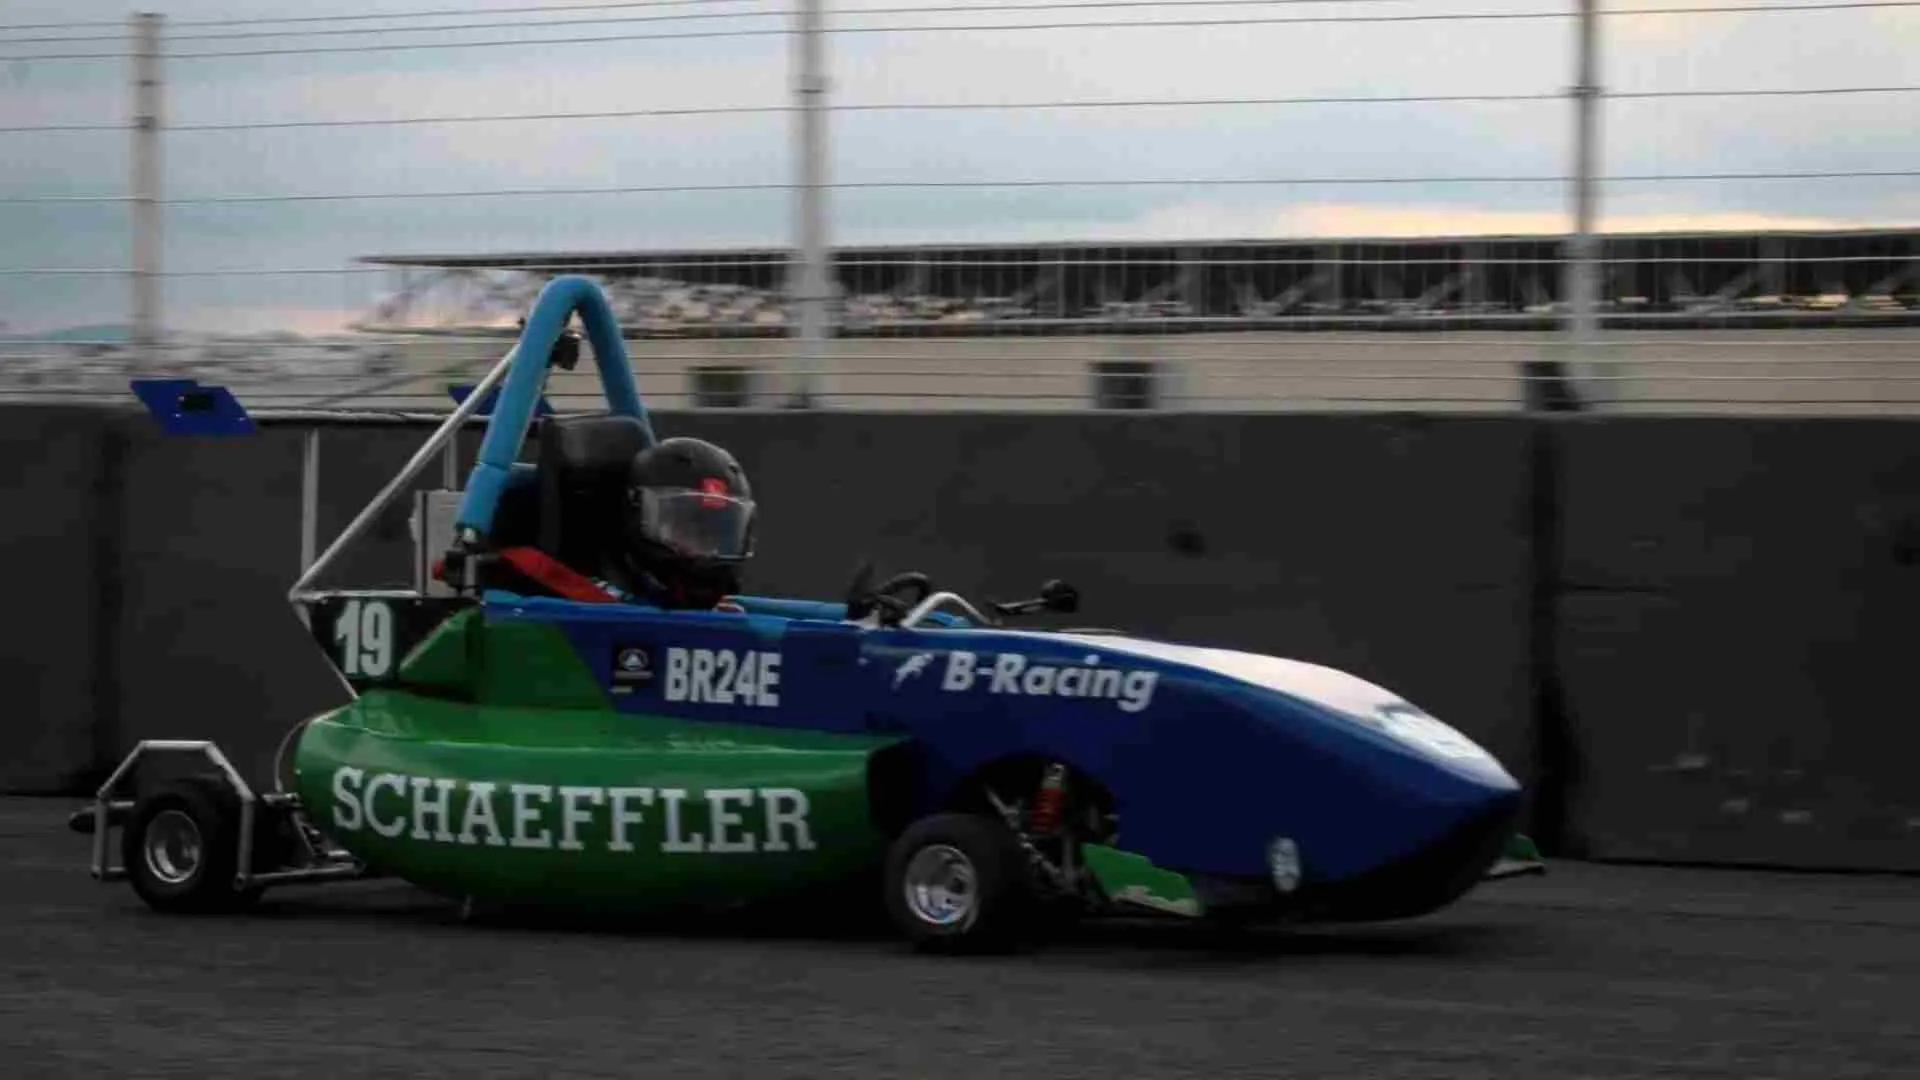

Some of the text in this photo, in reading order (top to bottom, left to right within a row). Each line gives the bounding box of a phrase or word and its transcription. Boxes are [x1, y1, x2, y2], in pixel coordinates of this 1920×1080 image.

[334, 599, 393, 677] 19
[664, 647, 783, 707] BR24E
[940, 649, 1159, 713] B-Racing
[332, 766, 817, 853] SCHAEFFLER
